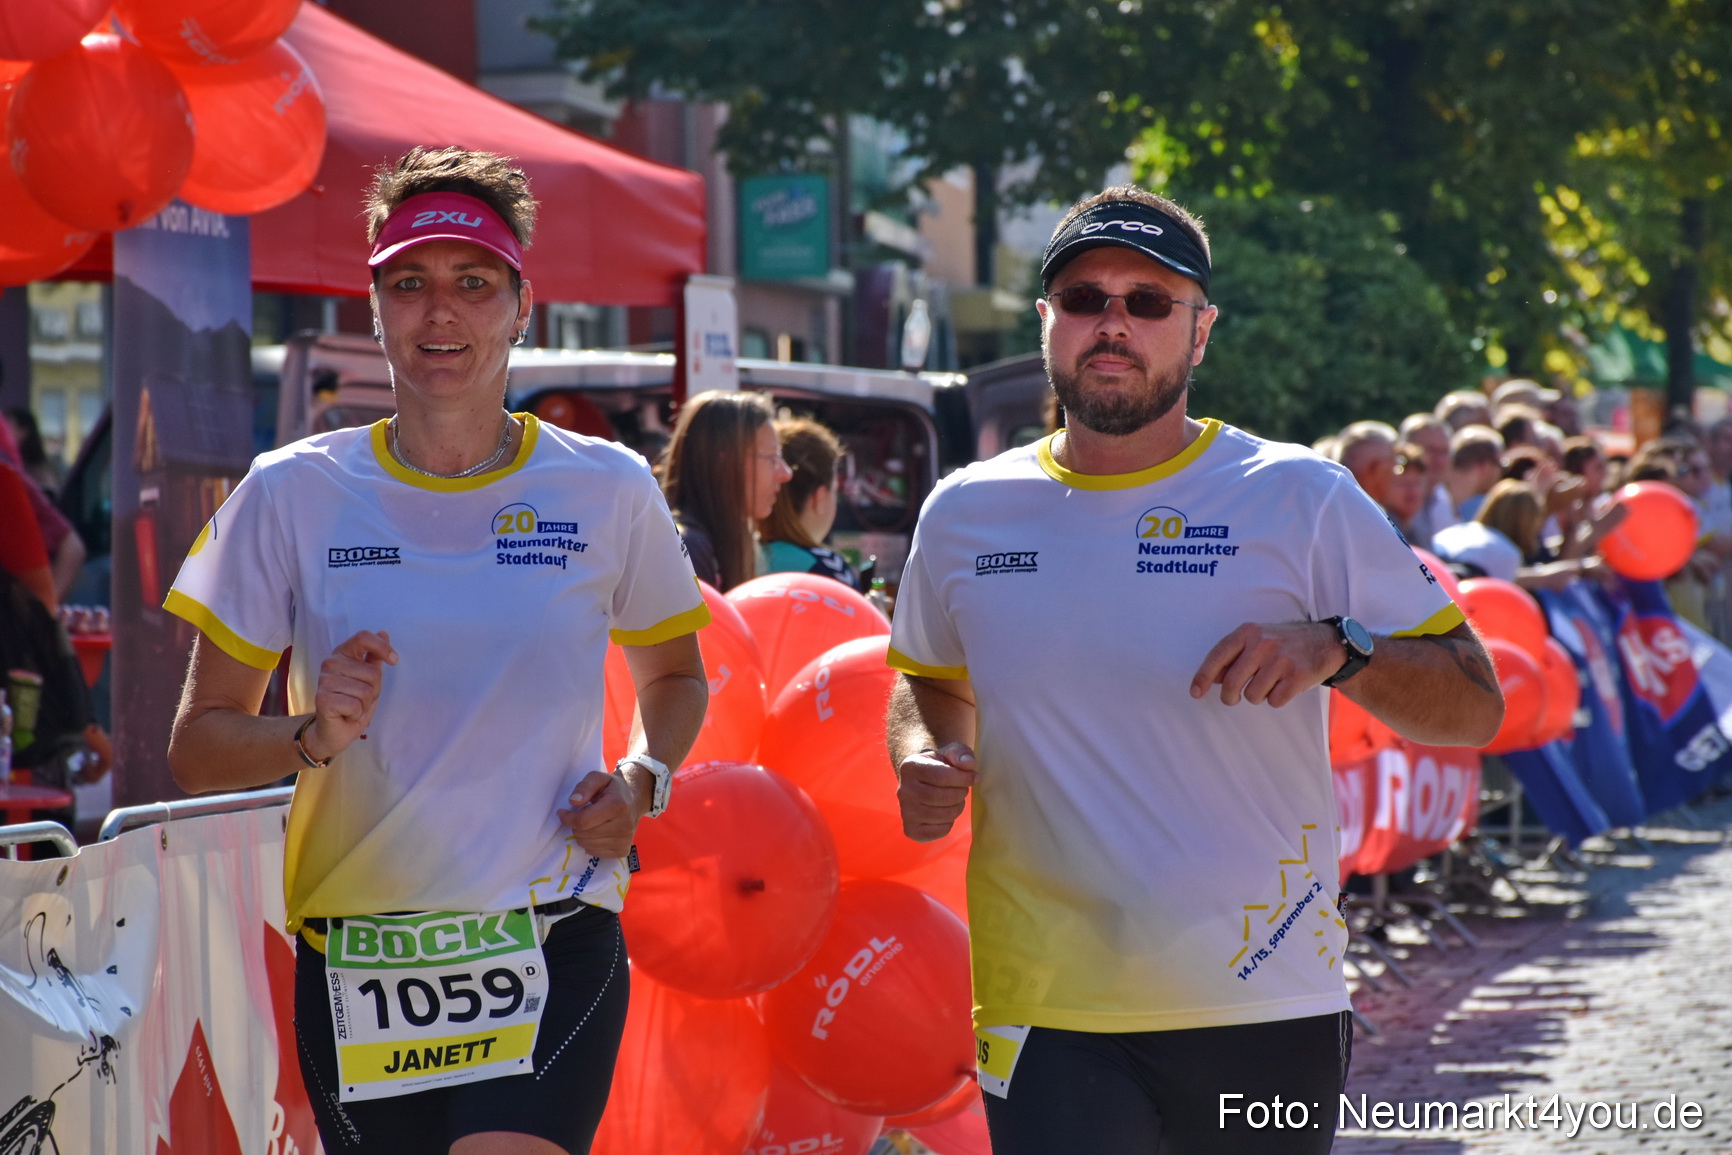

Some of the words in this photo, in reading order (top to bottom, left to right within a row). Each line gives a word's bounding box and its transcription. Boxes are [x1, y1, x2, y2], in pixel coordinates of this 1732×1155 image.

[411, 210, 483, 229] 2XU
[1081, 220, 1164, 237] orca
[497, 510, 535, 535] 20
[540, 523, 575, 532] JAHRE
[1141, 515, 1183, 539] 20
[1188, 527, 1226, 538] JAHRE
[496, 536, 589, 553] Neumarkter
[1138, 542, 1240, 556] Neumarkter
[329, 547, 400, 563] BOCK
[496, 552, 568, 570] Stadtlauf
[976, 552, 1039, 571] BOCK
[1136, 560, 1219, 577] Stadtlauf
[342, 914, 515, 963] BOCK
[1237, 948, 1272, 981] 14./15.
[1269, 890, 1315, 949] September
[525, 965, 536, 976] D
[860, 942, 904, 987] energie
[358, 967, 525, 1030] 1059
[384, 1037, 497, 1074] JANETT
[330, 1092, 357, 1133] CRAFT
